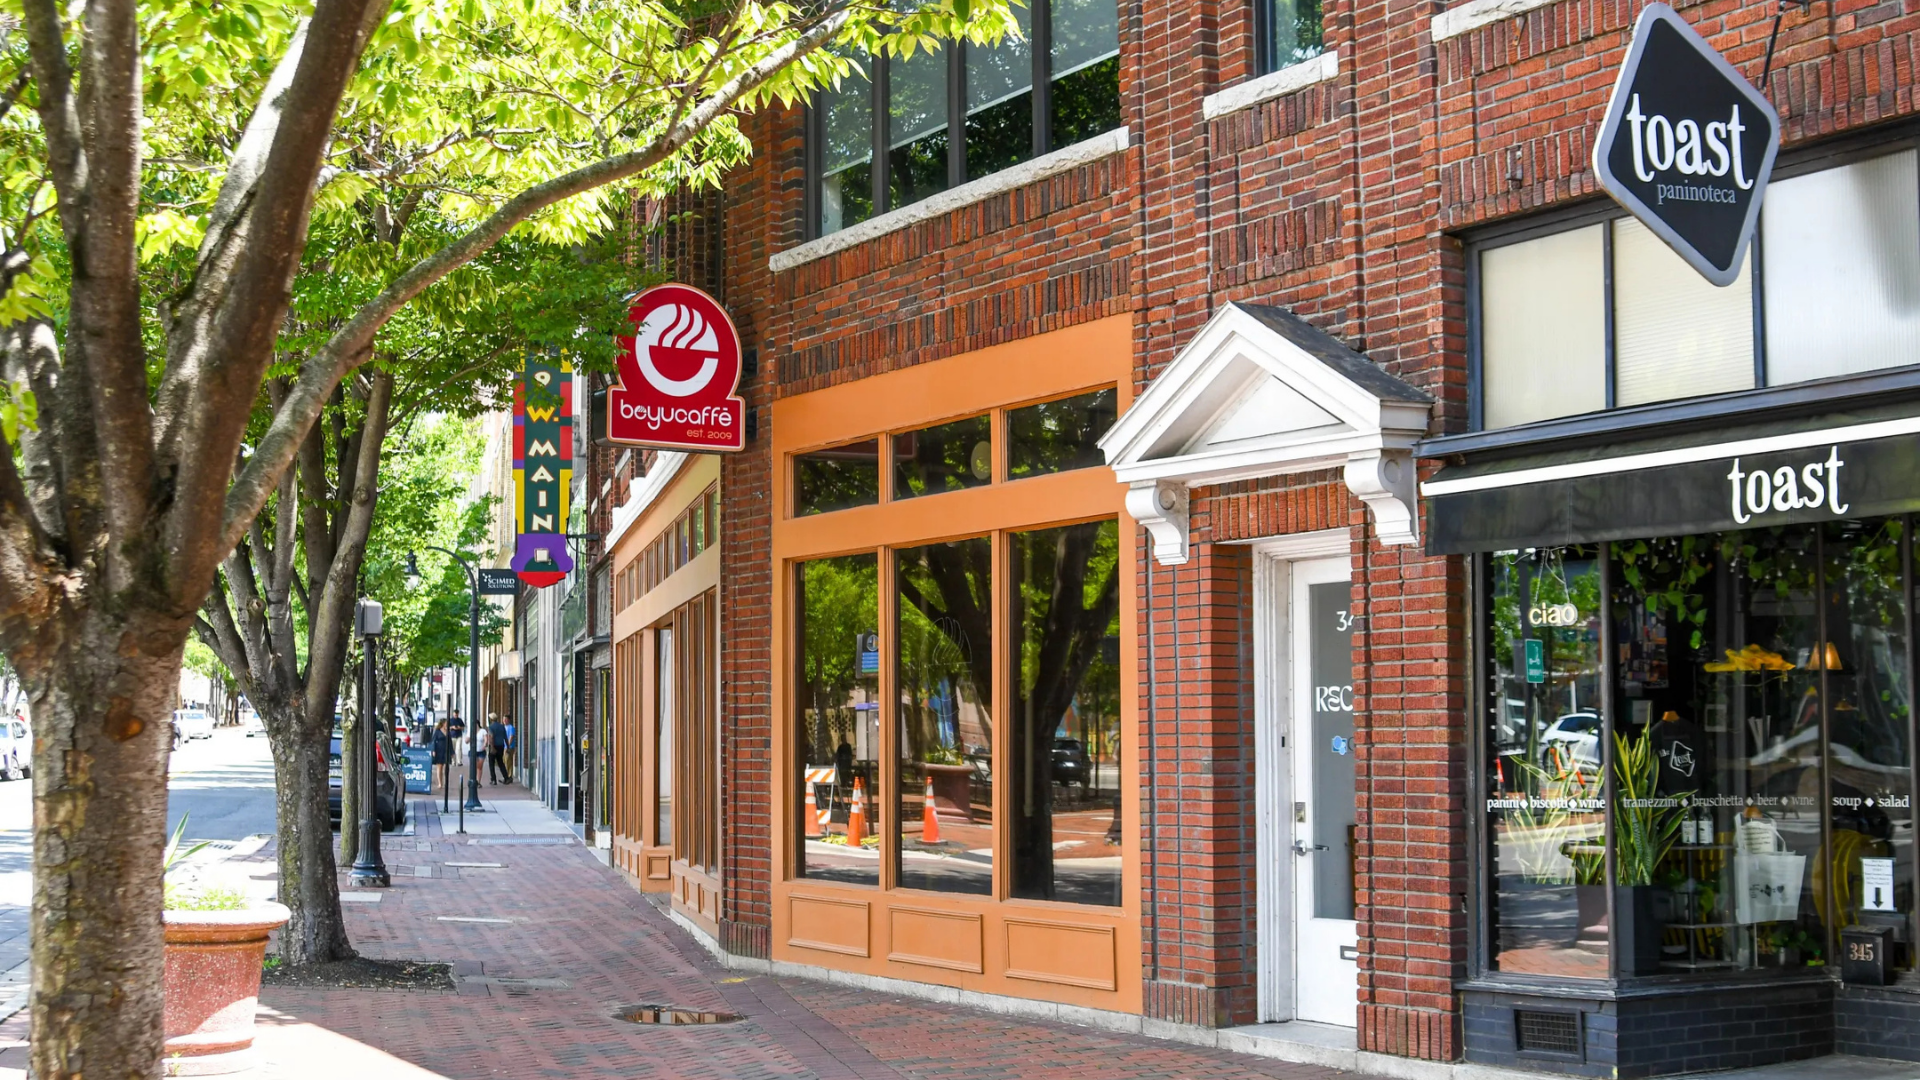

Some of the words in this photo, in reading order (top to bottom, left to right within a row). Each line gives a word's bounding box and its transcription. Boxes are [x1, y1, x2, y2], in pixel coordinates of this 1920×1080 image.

[1626, 92, 1754, 190] toast
[1656, 179, 1736, 205] paninoteca
[686, 429, 706, 438] est.
[707, 431, 733, 440] 2009
[527, 438, 558, 532] MAIN
[1727, 445, 1849, 525] toast
[1528, 602, 1576, 626] ciao
[1486, 796, 1520, 812] panini
[1529, 795, 1568, 809] biscotti
[1579, 796, 1606, 809] wine
[1622, 794, 1678, 808] tramezzini
[1691, 794, 1744, 807] bruschetta
[1757, 793, 1778, 806] beer
[1791, 795, 1815, 806] wine
[1832, 796, 1862, 810] soup
[1877, 794, 1910, 808] salad
[1849, 942, 1875, 962] 345
